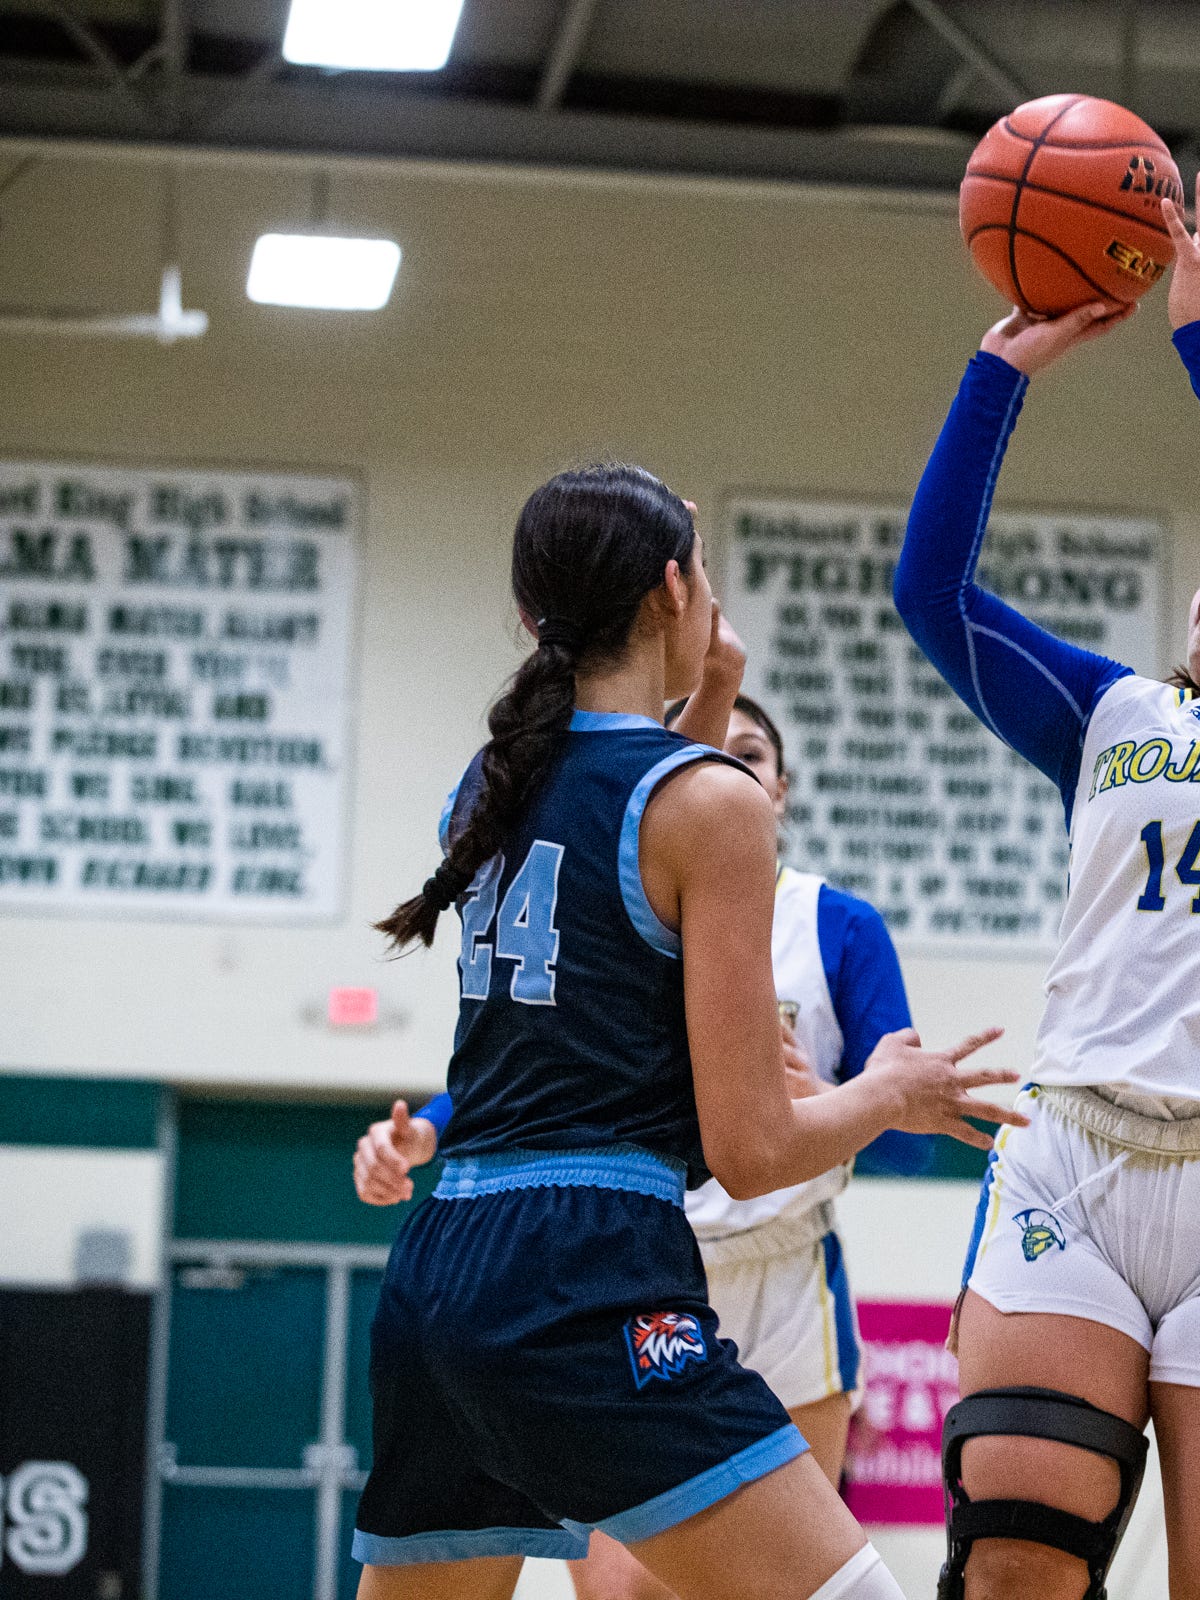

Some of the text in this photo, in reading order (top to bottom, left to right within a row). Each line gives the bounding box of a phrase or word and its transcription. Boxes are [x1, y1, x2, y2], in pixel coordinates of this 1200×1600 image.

[125, 533, 321, 592] MATER
[743, 551, 897, 598] FIGH
[460, 839, 566, 1007] 24
